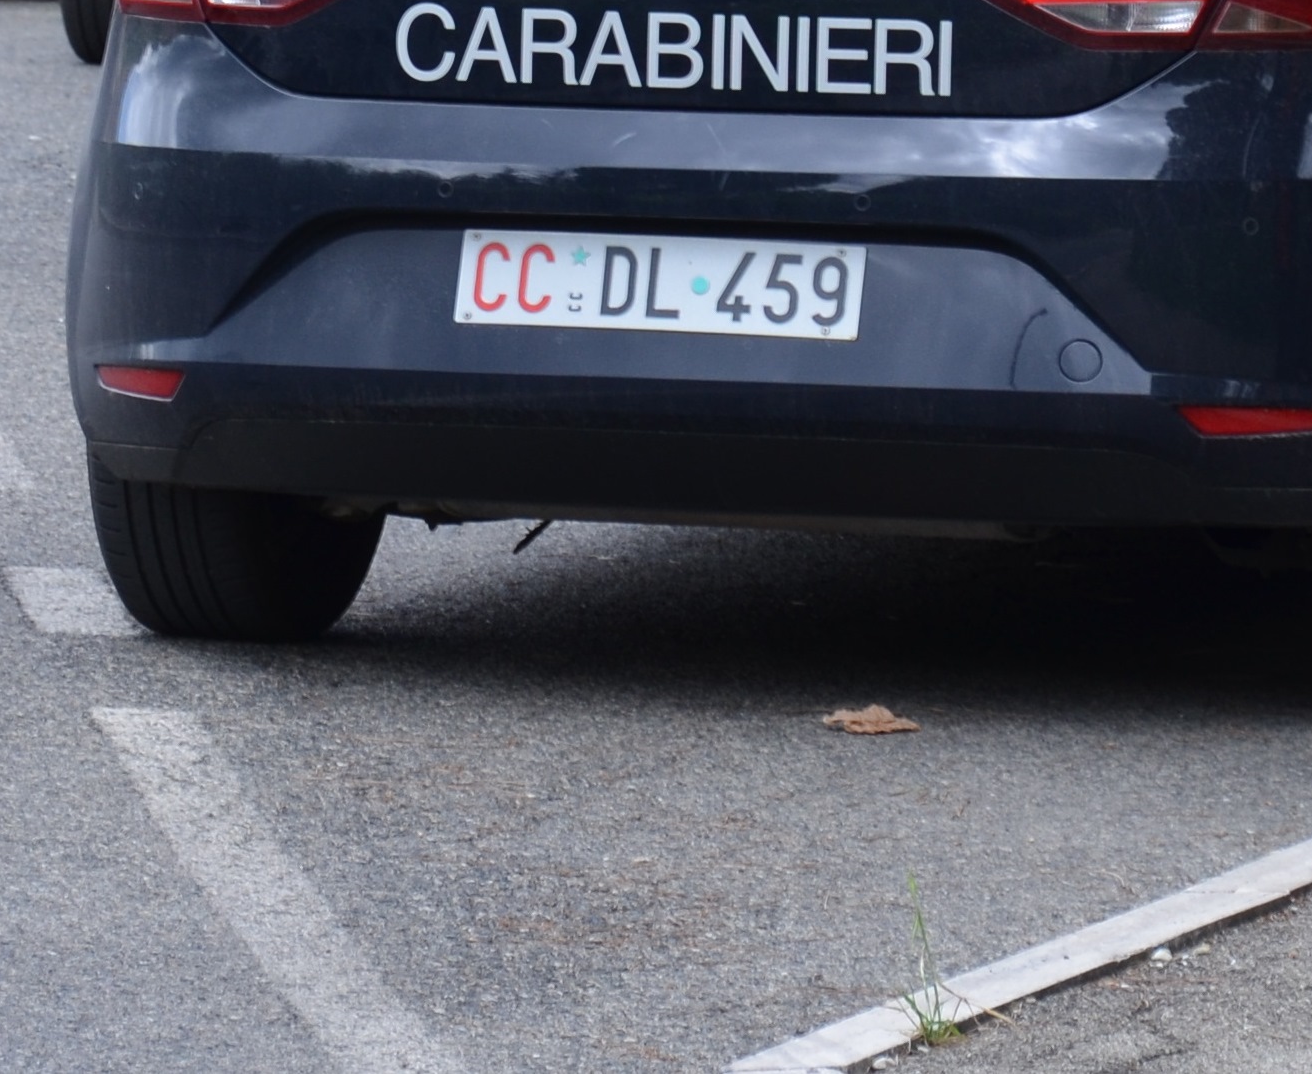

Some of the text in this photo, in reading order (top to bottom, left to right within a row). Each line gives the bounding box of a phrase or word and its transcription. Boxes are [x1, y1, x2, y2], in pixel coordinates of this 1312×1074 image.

[395, 2, 953, 97] CARABINIERI
[472, 242, 849, 327] CC DL 459
